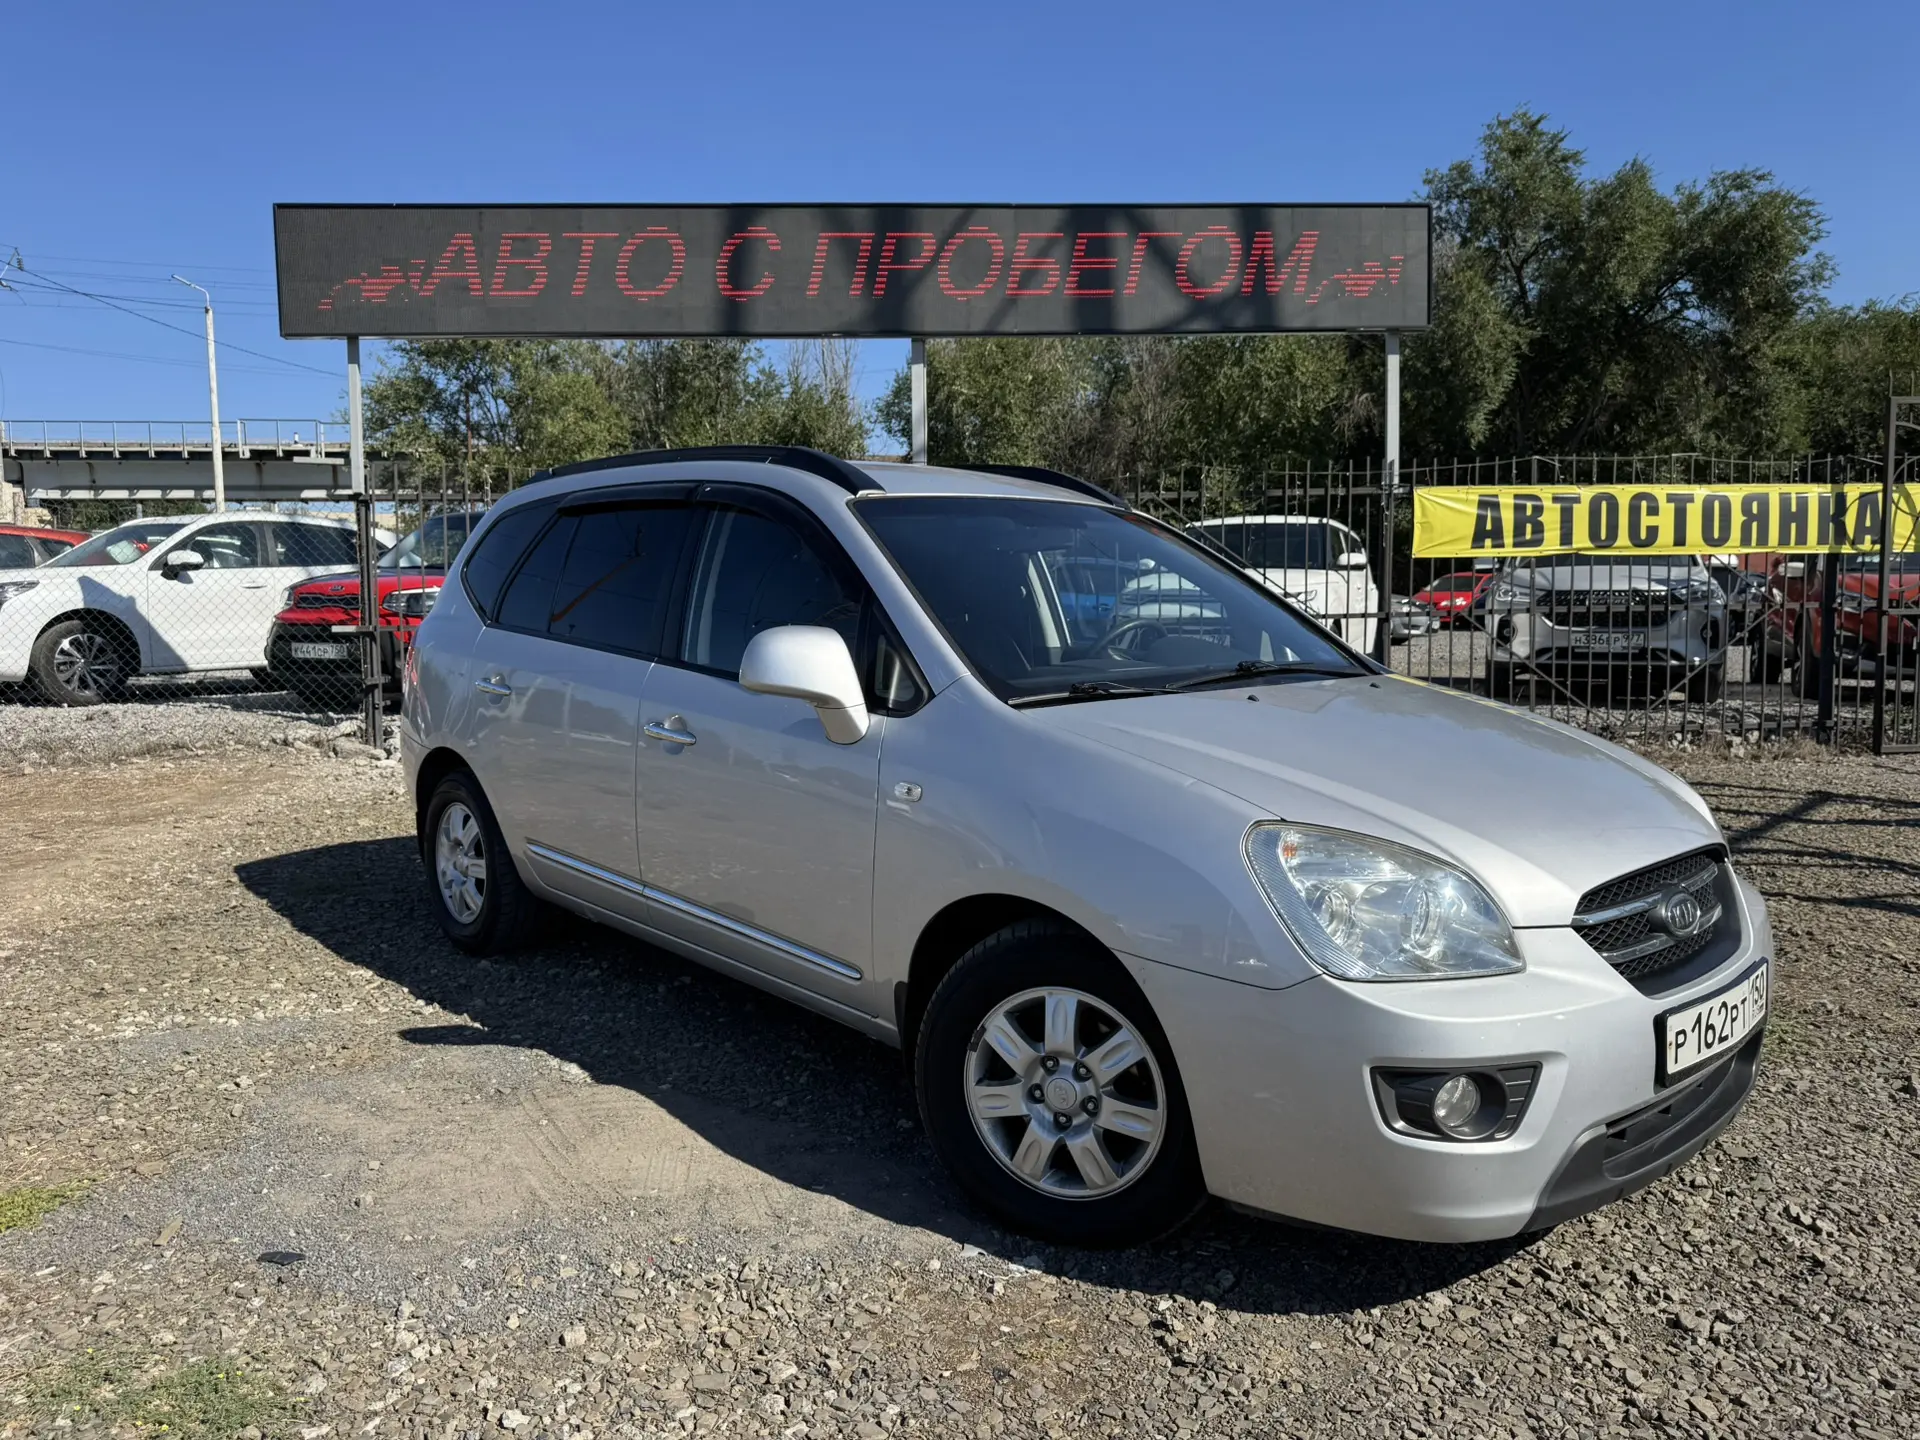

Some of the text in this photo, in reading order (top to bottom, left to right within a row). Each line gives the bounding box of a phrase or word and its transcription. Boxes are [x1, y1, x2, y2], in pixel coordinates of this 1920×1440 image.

[419, 226, 1320, 301] АВТО С ПРОБЕГОМ
[1471, 491, 1883, 549] АВТОСТОЯНКА
[1674, 995, 1748, 1065] Р162РТ
